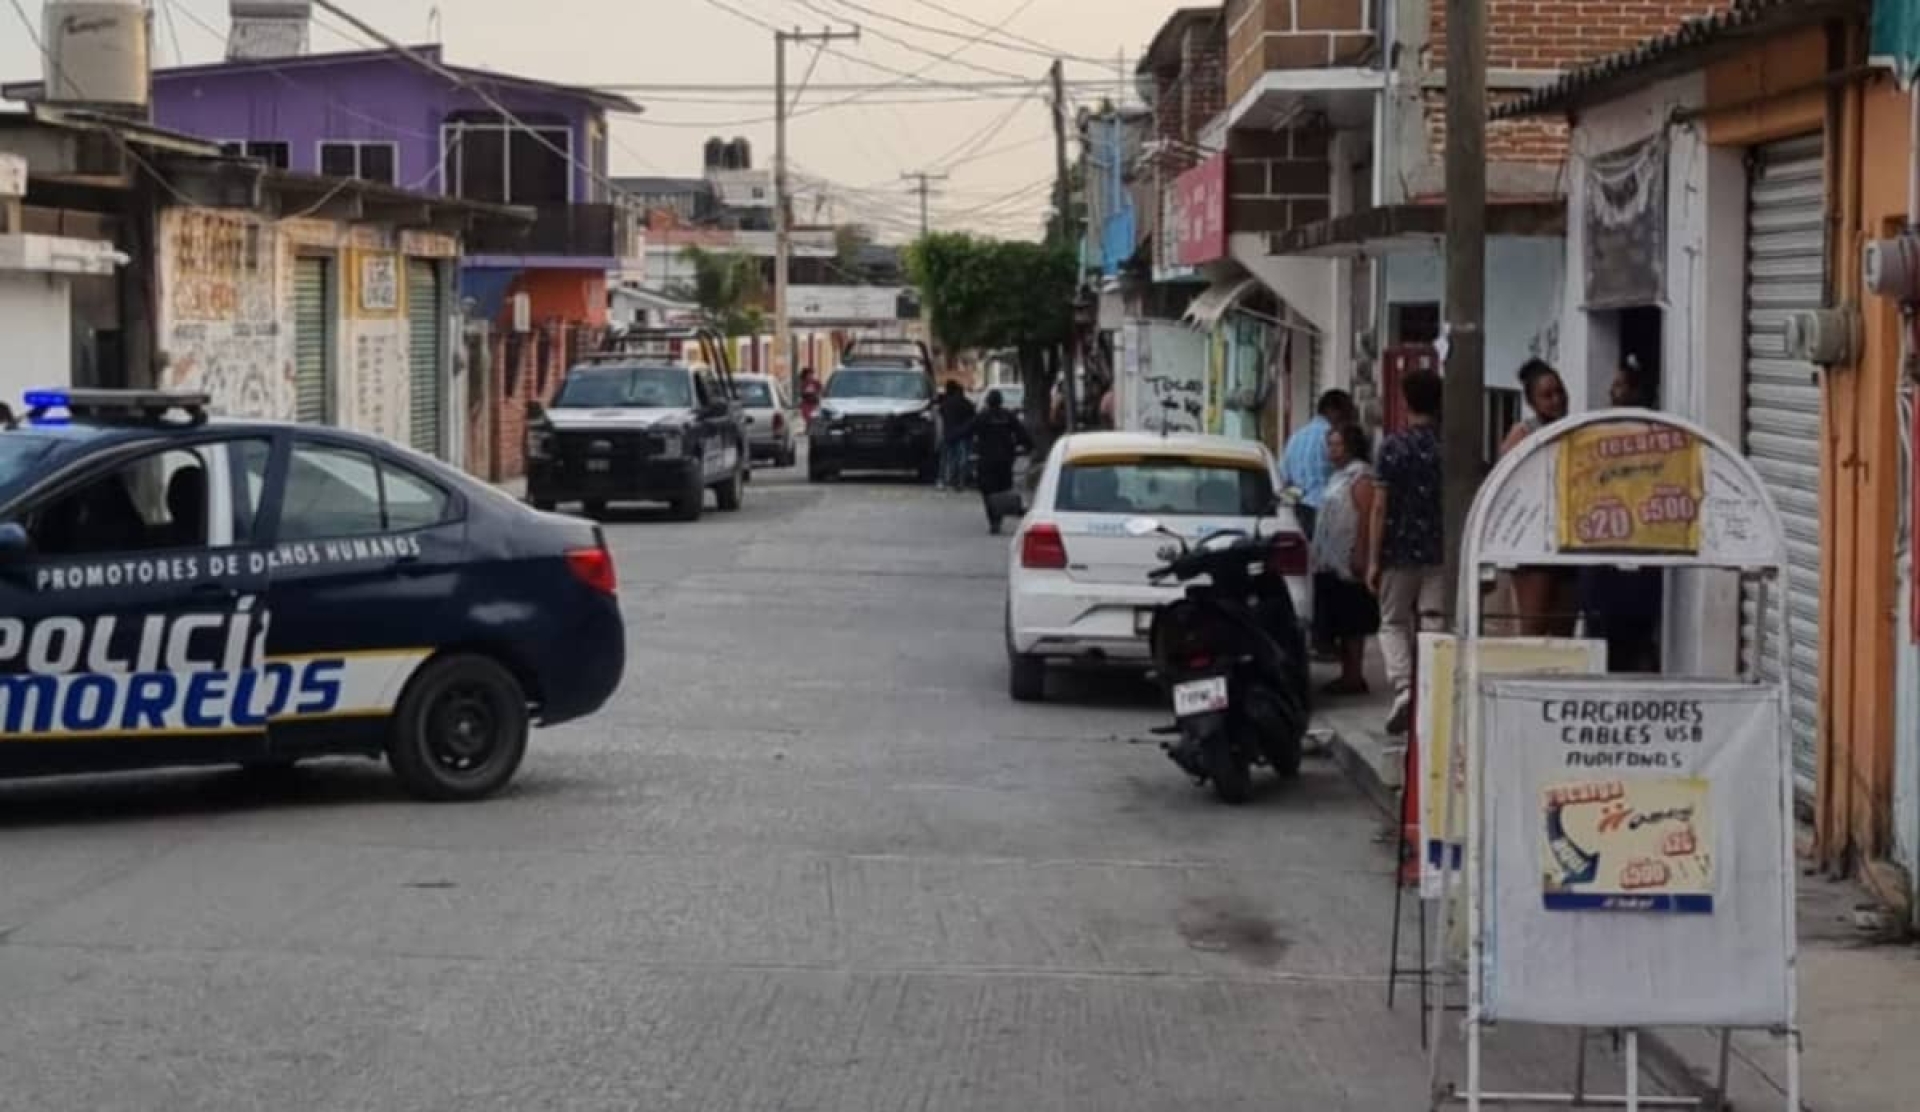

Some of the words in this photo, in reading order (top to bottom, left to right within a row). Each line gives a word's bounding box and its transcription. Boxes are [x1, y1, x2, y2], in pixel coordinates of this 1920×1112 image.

[37, 556, 199, 591] PROMOTORES
[208, 554, 240, 577] DE
[325, 536, 421, 561] HUMANOS
[1542, 699, 1703, 724] CARGADORES
[1561, 724, 1652, 745] CABLES
